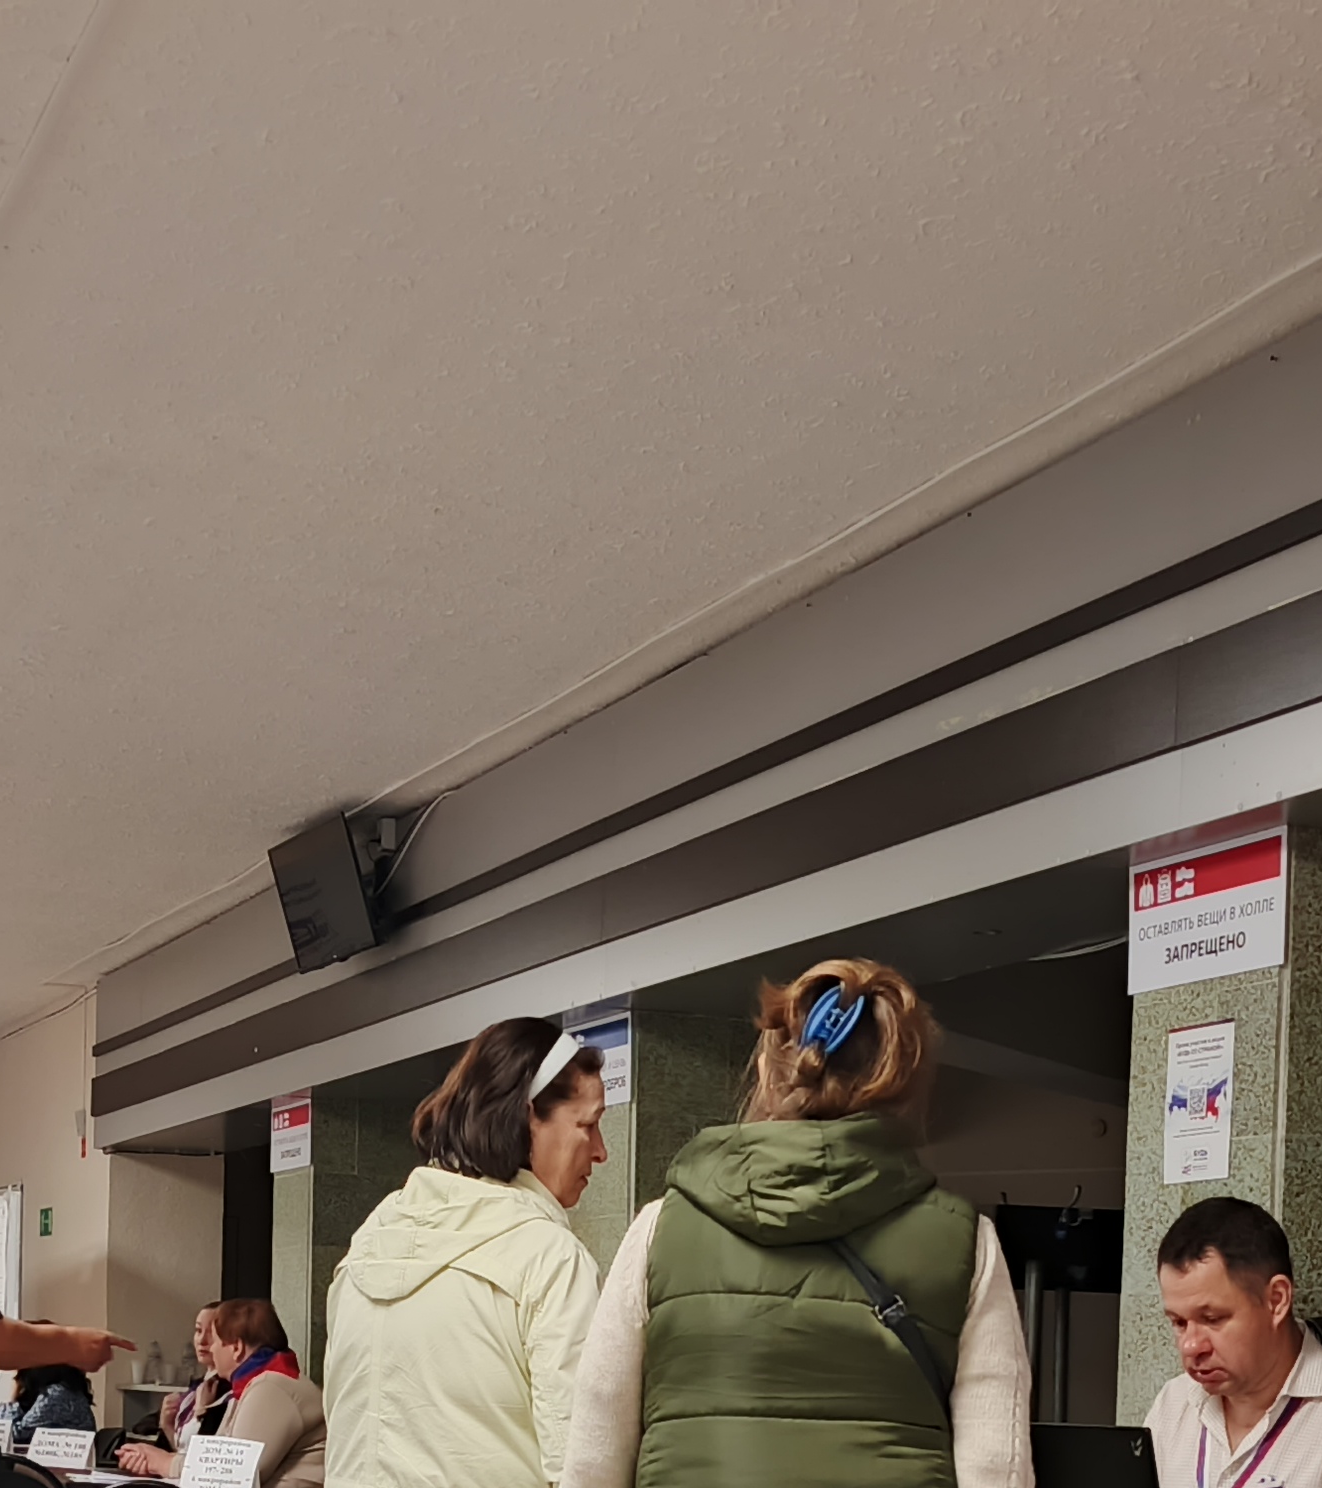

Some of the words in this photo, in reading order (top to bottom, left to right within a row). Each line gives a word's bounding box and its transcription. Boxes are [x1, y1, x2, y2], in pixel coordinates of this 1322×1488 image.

[1138, 916, 1195, 941] ОСТАВЛЯТЬ
[1197, 908, 1227, 928] ВЕЩИ
[1229, 906, 1236, 920] В
[1238, 896, 1275, 919] ХОЛЛЕ
[1164, 931, 1247, 965] ЗАПРЕЩЕНО
[198, 1456, 244, 1466] КВАРТИРЫ
